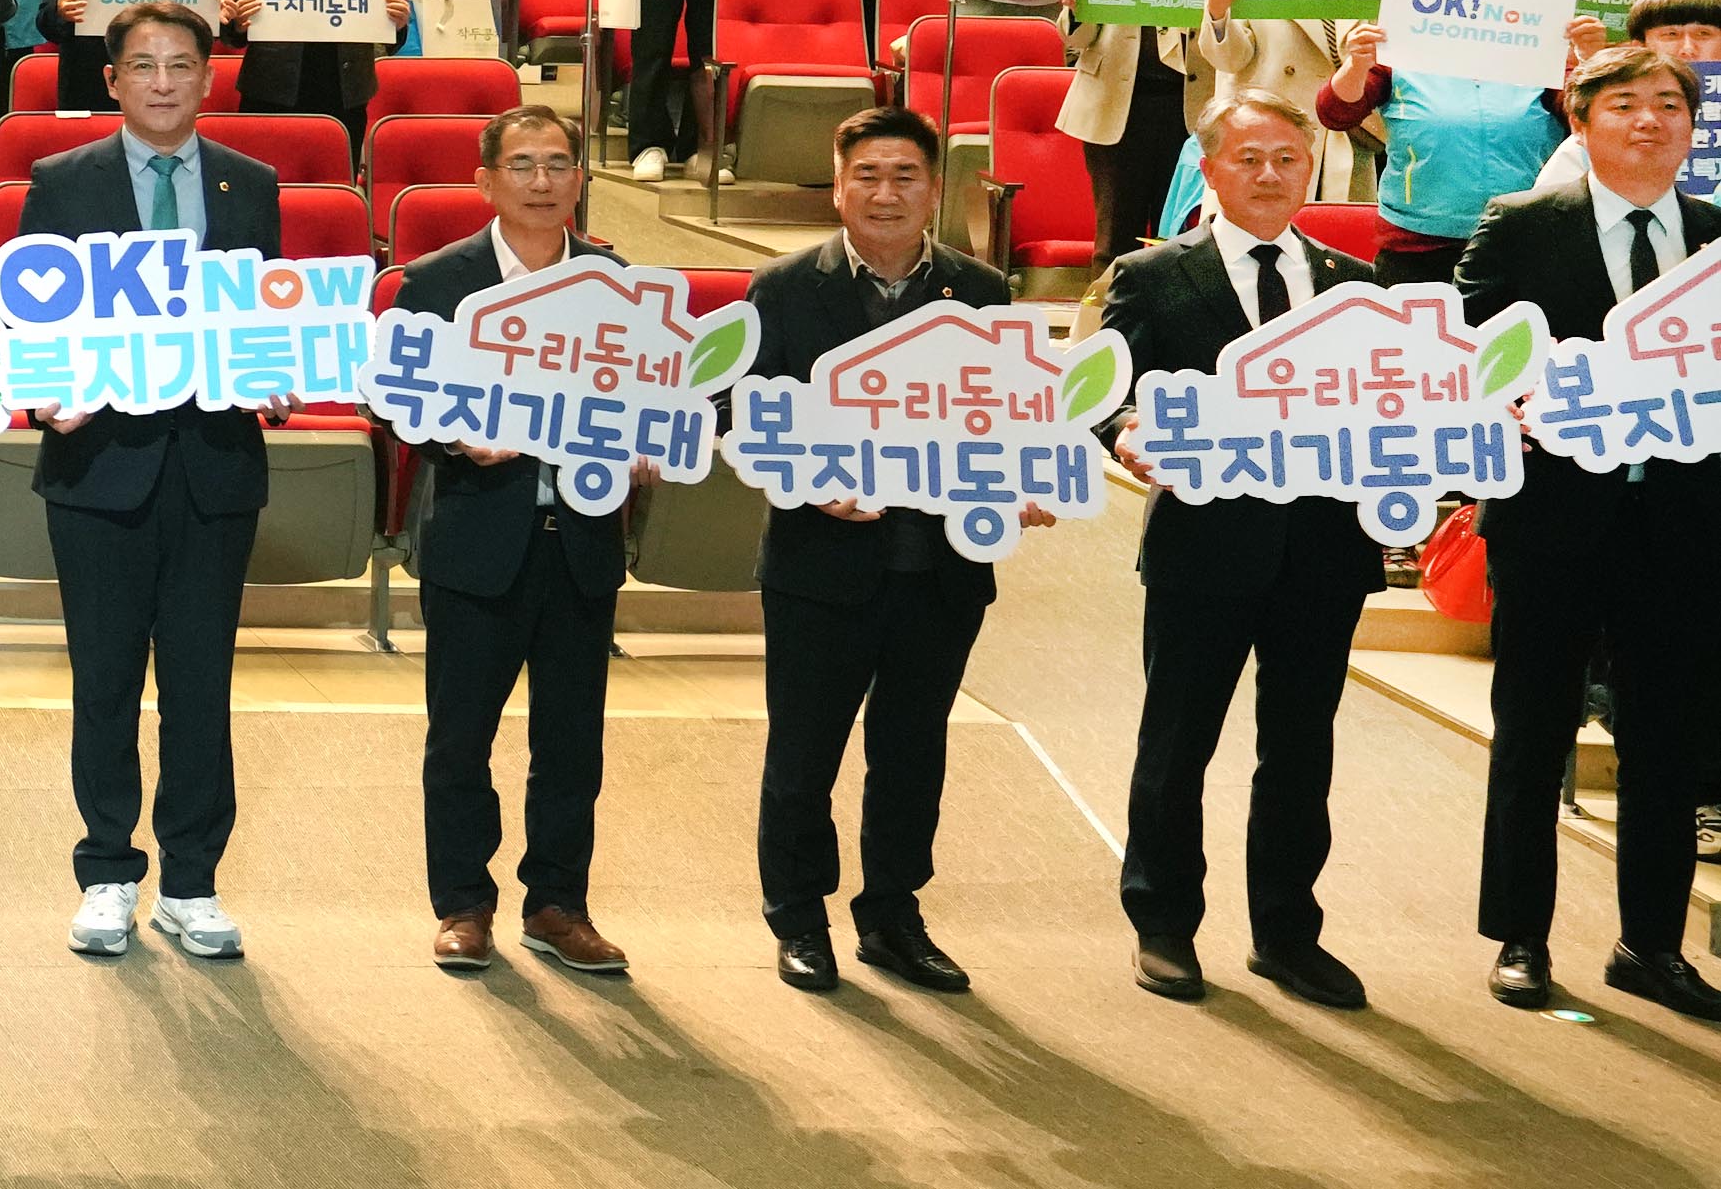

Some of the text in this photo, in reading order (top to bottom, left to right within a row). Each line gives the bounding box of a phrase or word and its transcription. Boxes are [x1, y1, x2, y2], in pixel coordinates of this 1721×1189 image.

[1410, 18, 1539, 48] Jeonnam
[1484, 6, 1542, 26] Now
[0, 237, 365, 322] OK! Now
[7, 320, 361, 407] 복지기동대
[484, 316, 683, 392] 우리동네
[1254, 349, 1468, 418] 우리동네
[376, 324, 703, 500] 복지기동대
[843, 369, 1057, 434] 우리동네
[1540, 353, 1721, 457] 복지
[739, 390, 1088, 545] 복지기동대
[1145, 386, 1507, 533] 복지기동대
